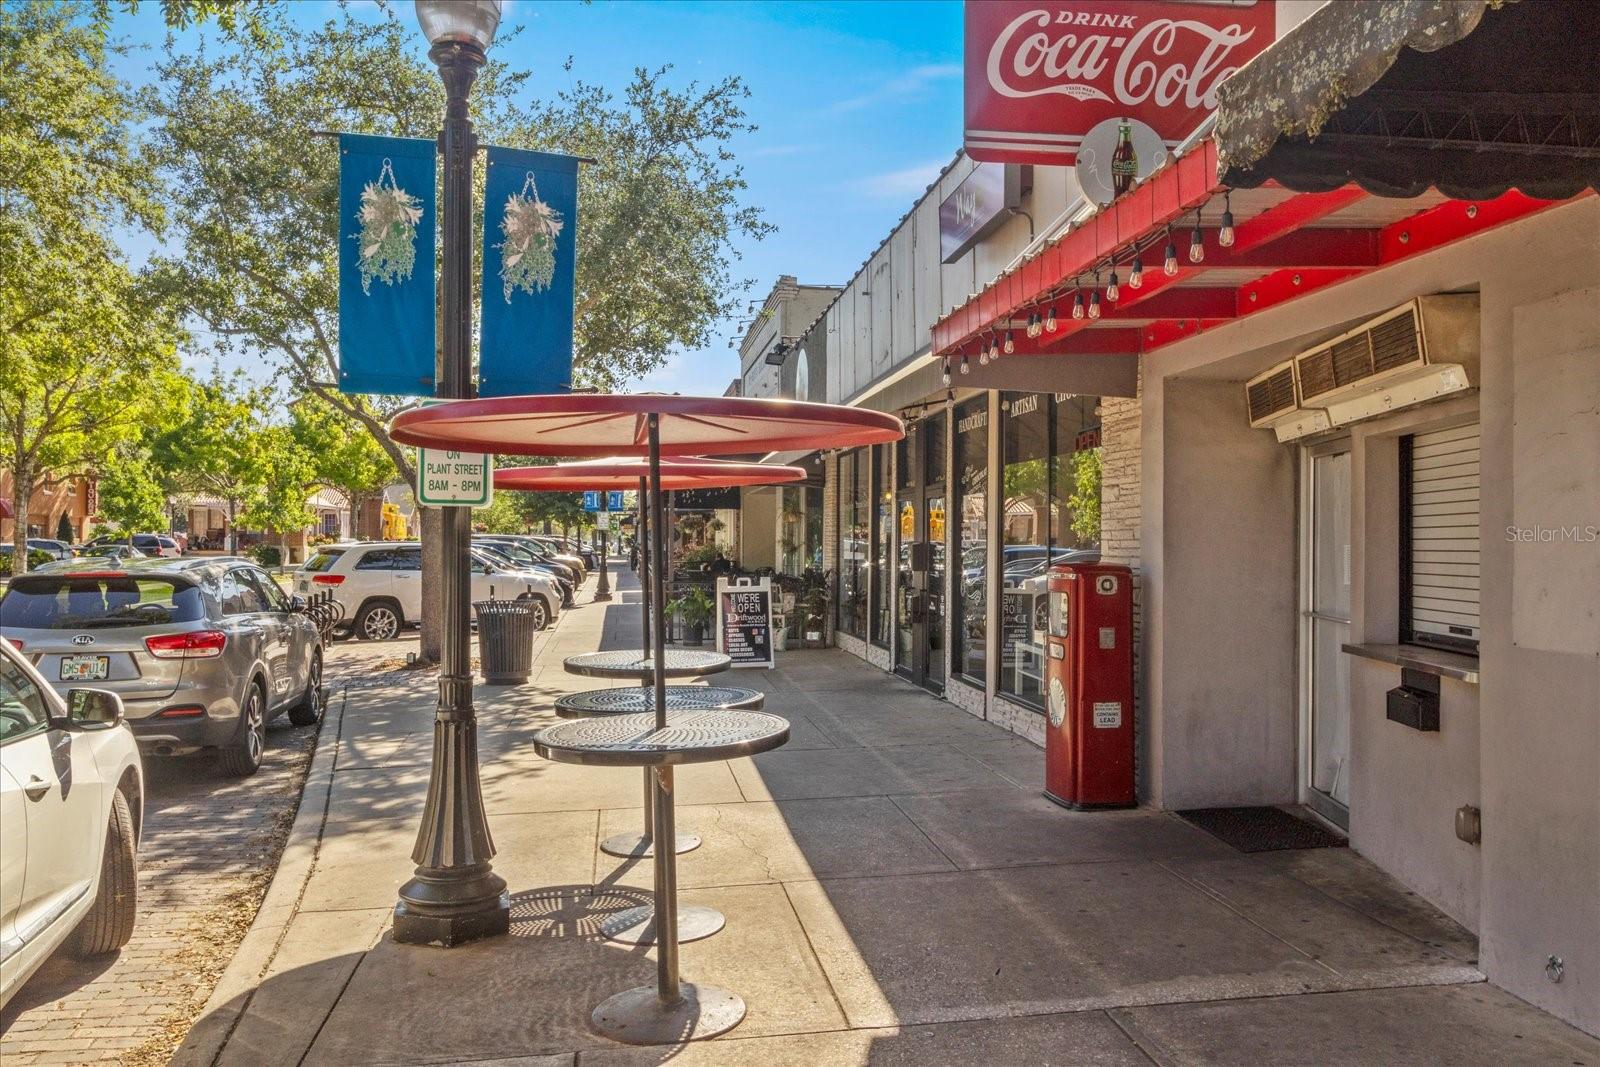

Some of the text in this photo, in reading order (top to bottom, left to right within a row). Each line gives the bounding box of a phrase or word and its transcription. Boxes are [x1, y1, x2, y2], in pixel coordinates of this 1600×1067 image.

[1054, 10, 1139, 29] DRINK
[1010, 394, 1038, 418] ARTISAN
[446, 451, 461, 459] ON
[427, 463, 483, 475] PLANT STREET
[428, 480, 449, 491] 8AM
[461, 480, 481, 492] 8PM
[737, 593, 760, 603] WE'RE
[737, 603, 761, 613] OPEN
[726, 613, 766, 623] Driftwood
[75, 636, 91, 644] KIA
